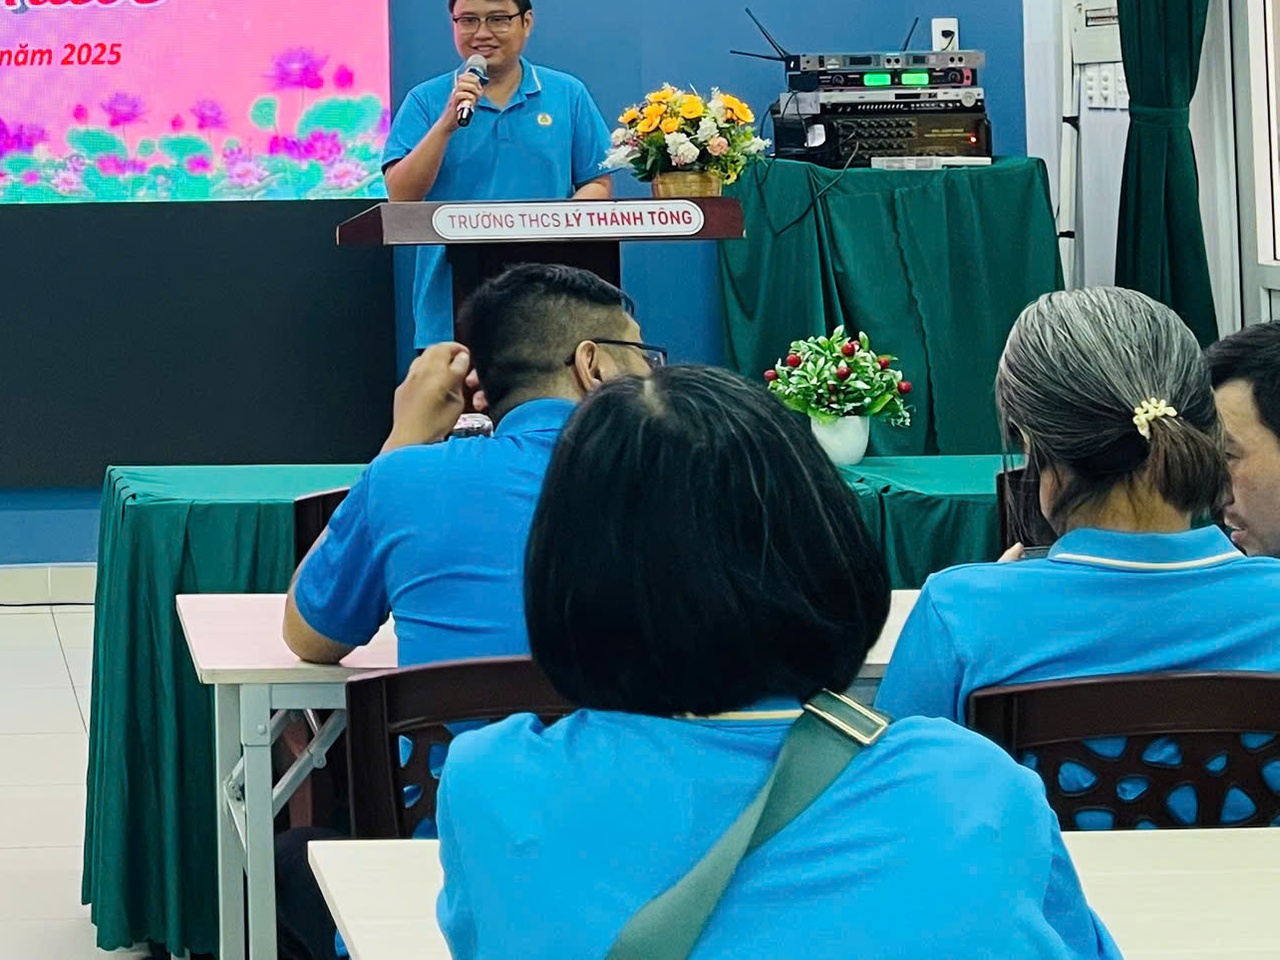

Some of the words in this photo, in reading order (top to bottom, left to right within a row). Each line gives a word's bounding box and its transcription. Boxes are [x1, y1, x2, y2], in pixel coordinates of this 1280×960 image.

[60, 43, 122, 66] 2025
[448, 211, 515, 230] TRƯỜNG
[518, 212, 561, 229] THCS
[565, 208, 582, 228] LÝ
[586, 207, 644, 227] THÁNH
[647, 207, 693, 226] TÔNG
